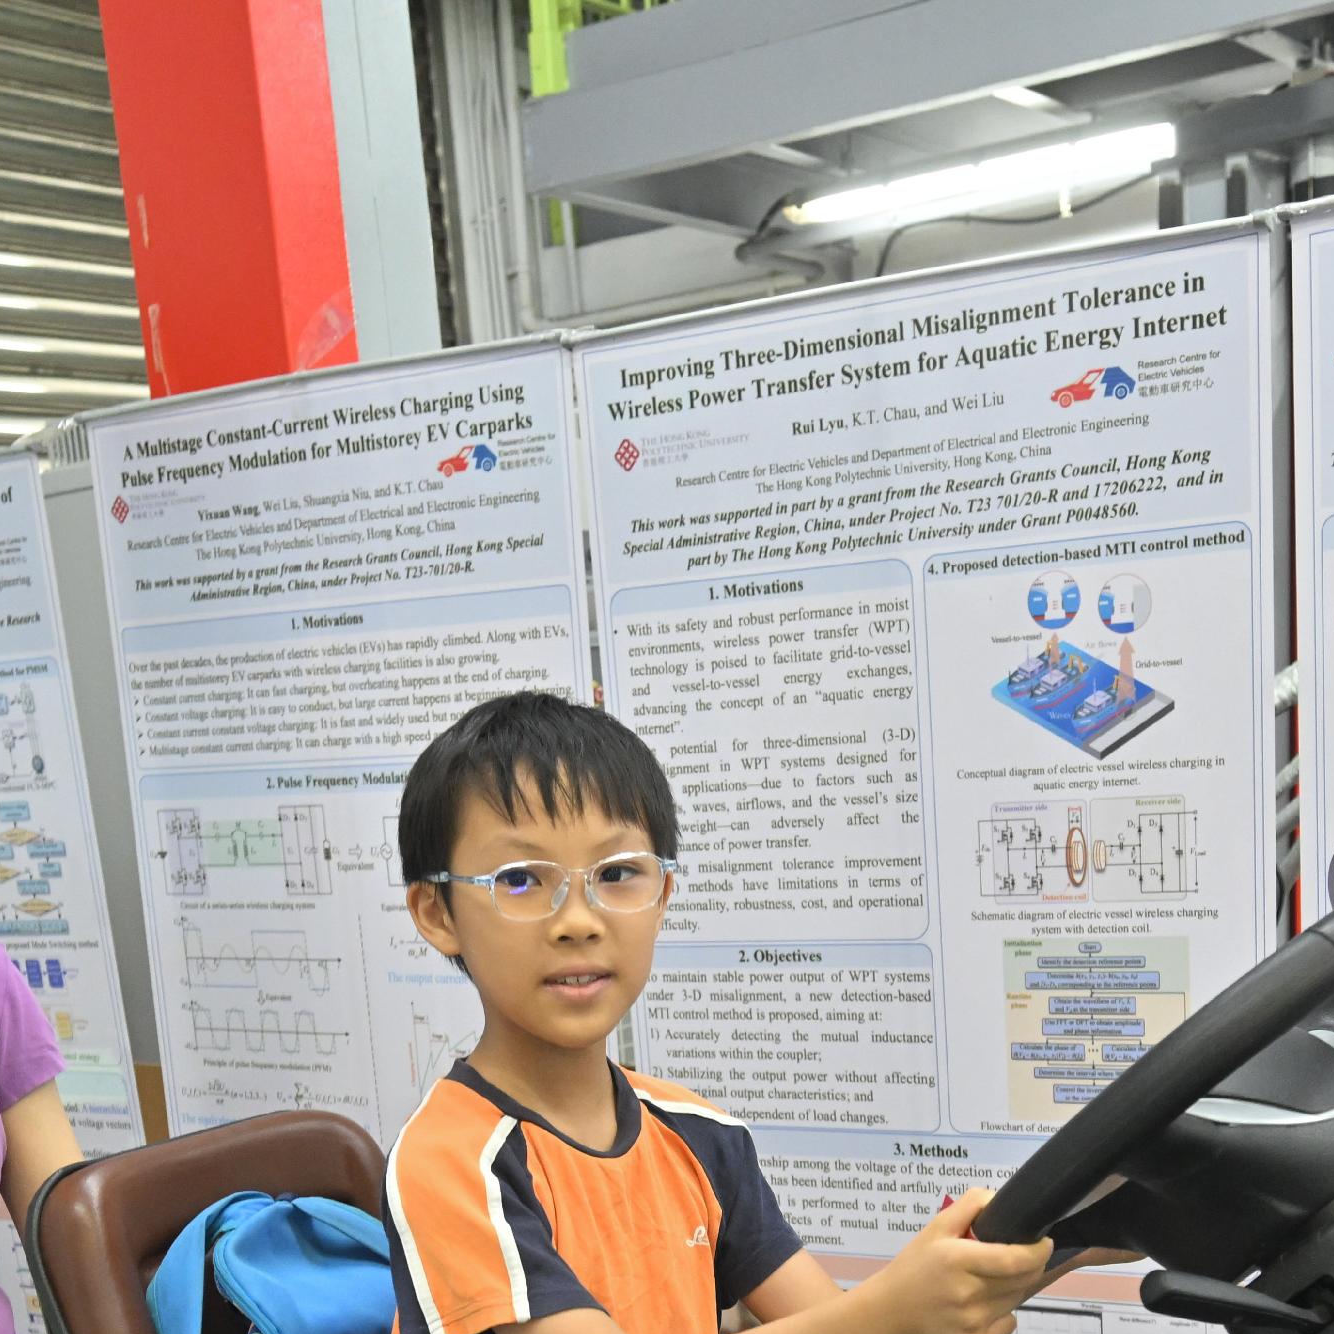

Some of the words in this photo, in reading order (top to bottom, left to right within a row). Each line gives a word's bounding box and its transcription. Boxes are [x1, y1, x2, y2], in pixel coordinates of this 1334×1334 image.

[620, 357, 715, 389] Improving
[719, 320, 904, 371] Three-Dimensional
[912, 297, 1056, 339] Misalignment
[1062, 281, 1176, 313] Tolerance
[1183, 276, 1205, 294] in
[607, 396, 683, 421] Wireless
[689, 387, 746, 409] Power
[751, 369, 835, 399] Transfer
[841, 360, 911, 385] System
[917, 351, 948, 373] for
[955, 335, 1037, 370] Aquatic
[1045, 326, 1124, 353] Energy
[1133, 305, 1227, 339] Internet
[123, 445, 133, 461] A
[136, 437, 203, 458] Multistage
[206, 413, 329, 447] Constant-Current
[332, 404, 396, 426] Wireless
[400, 393, 474, 417] Charging
[479, 385, 525, 405] Using
[0, 487, 12, 504] of
[709, 587, 719, 601] 1.
[723, 579, 804, 598] Motivations
[738, 949, 750, 963] 2.
[753, 949, 822, 967] Objectives
[893, 1142, 905, 1156] 3.
[910, 1143, 968, 1159] Methods
